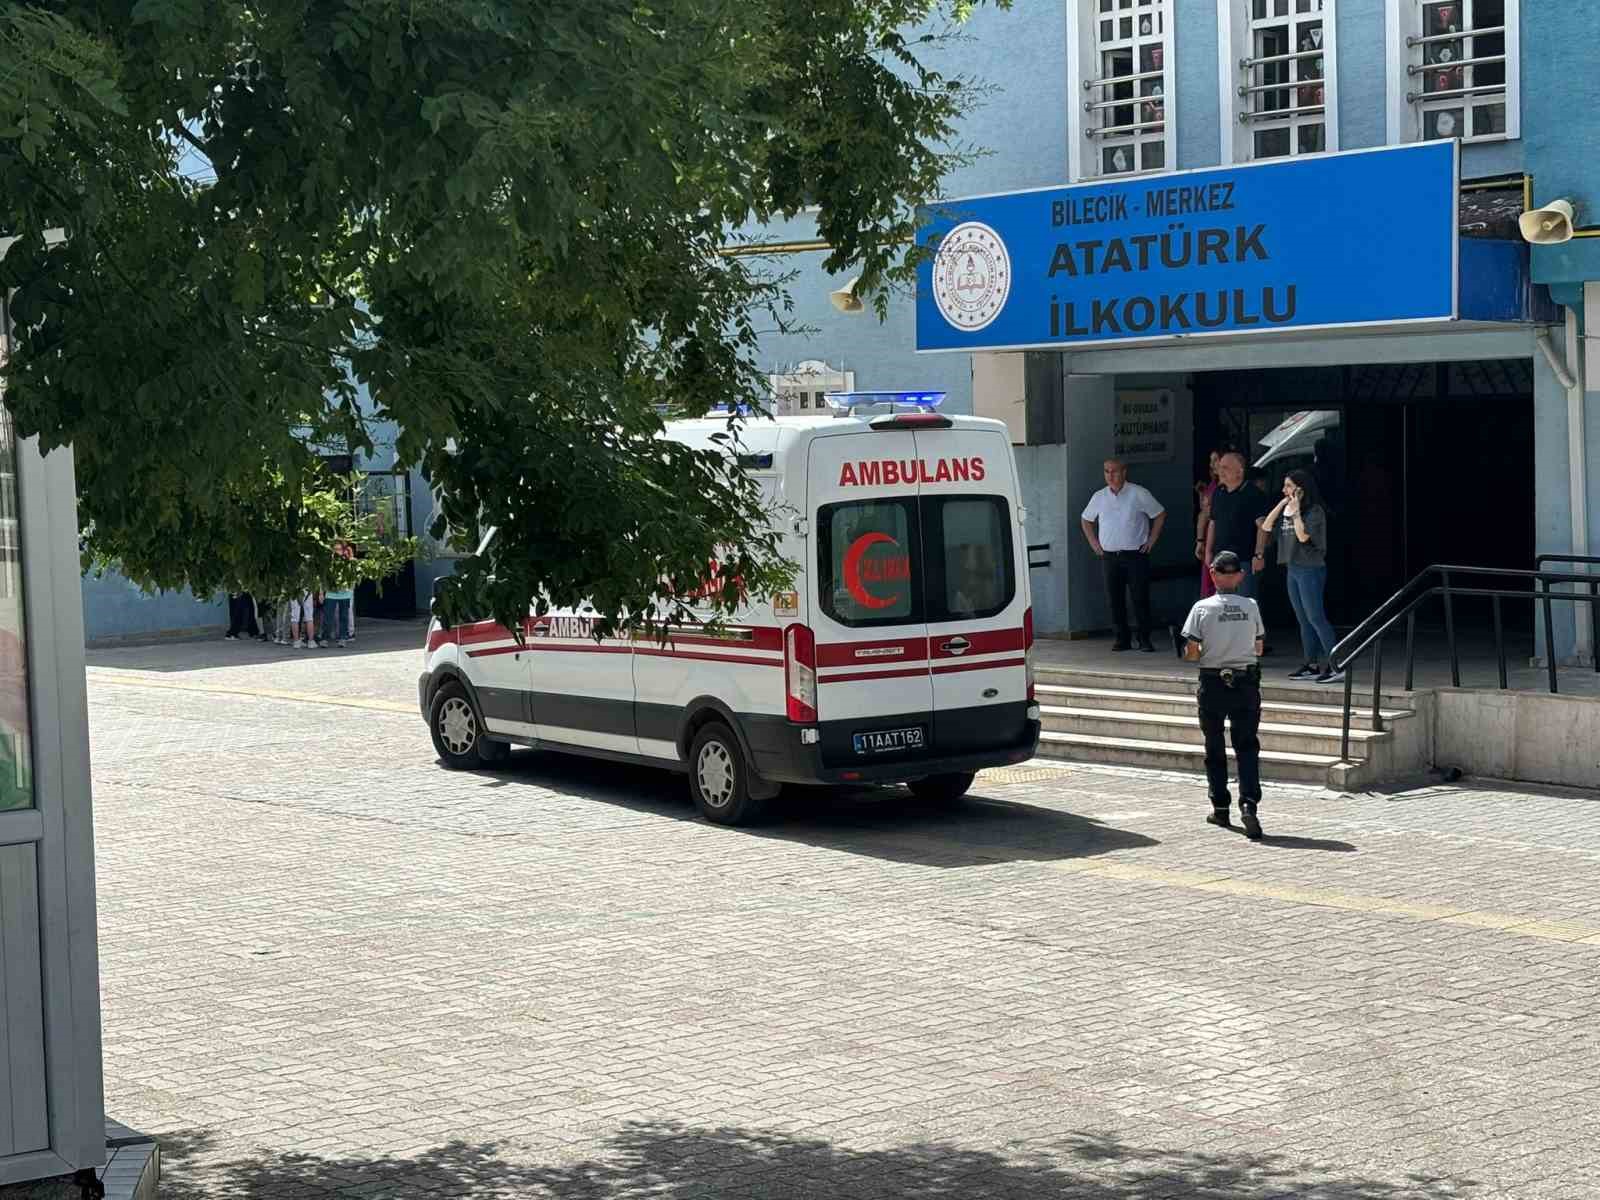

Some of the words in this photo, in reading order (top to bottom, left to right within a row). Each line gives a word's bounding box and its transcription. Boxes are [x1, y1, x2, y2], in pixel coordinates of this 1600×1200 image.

[1146, 182, 1235, 217] MERKEZ
[1048, 223, 1269, 278] ATATÜRK
[1050, 285, 1296, 337] İLKOKULU
[839, 457, 985, 487] AMBULANS
